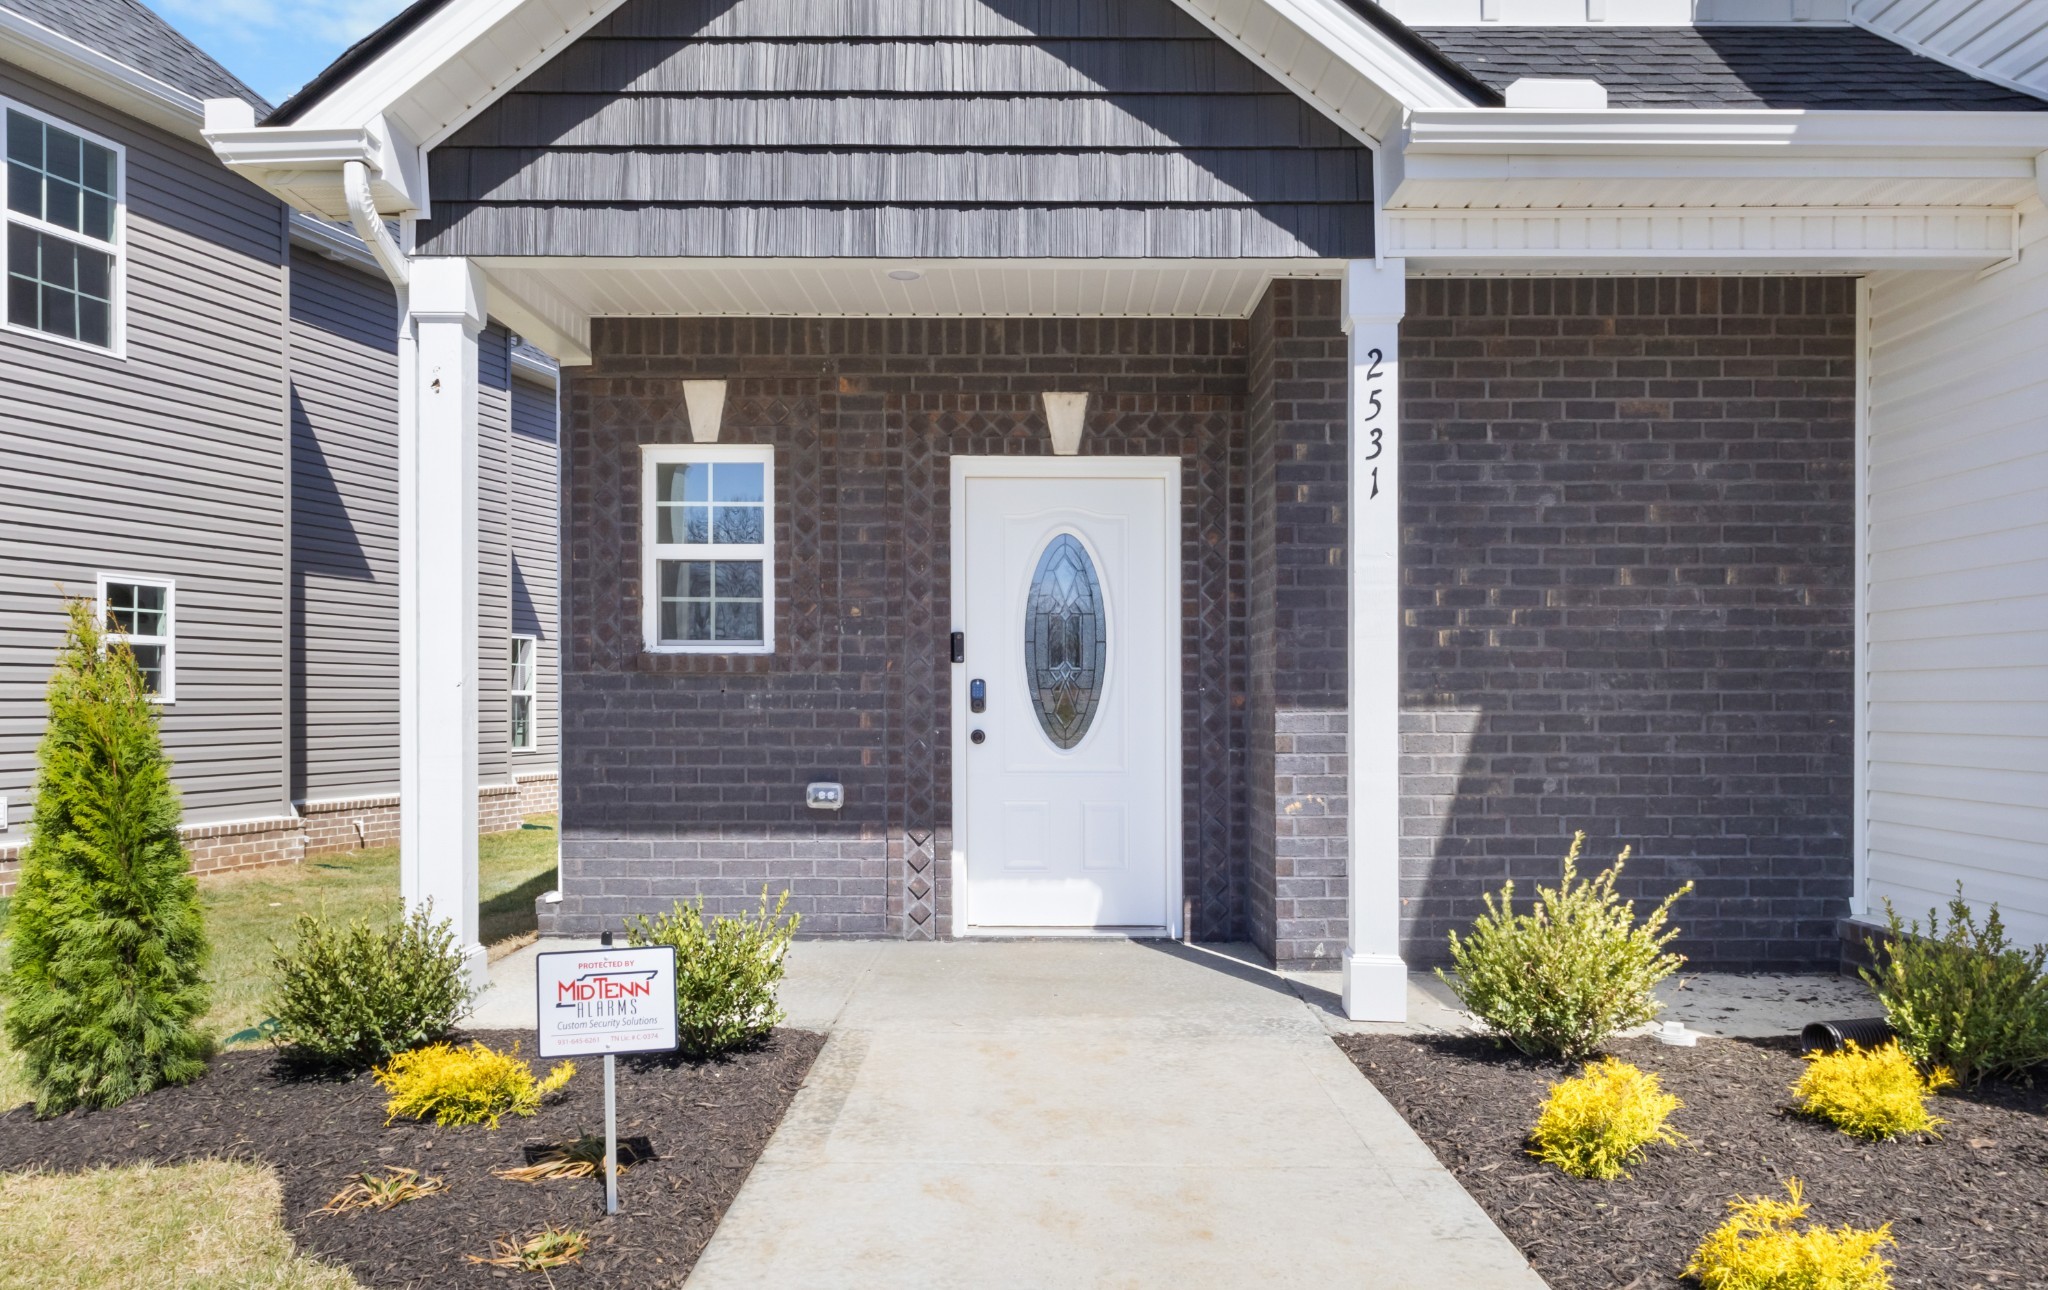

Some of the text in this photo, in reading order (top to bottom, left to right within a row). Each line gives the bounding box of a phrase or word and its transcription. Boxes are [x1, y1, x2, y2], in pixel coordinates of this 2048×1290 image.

[1364, 348, 1384, 500] 2531
[578, 961, 623, 969] PROTECTED
[577, 998, 637, 1018] ALARMS
[557, 1016, 658, 1031] Custom Security Solutions
[557, 1037, 600, 1045] 931-645-6261
